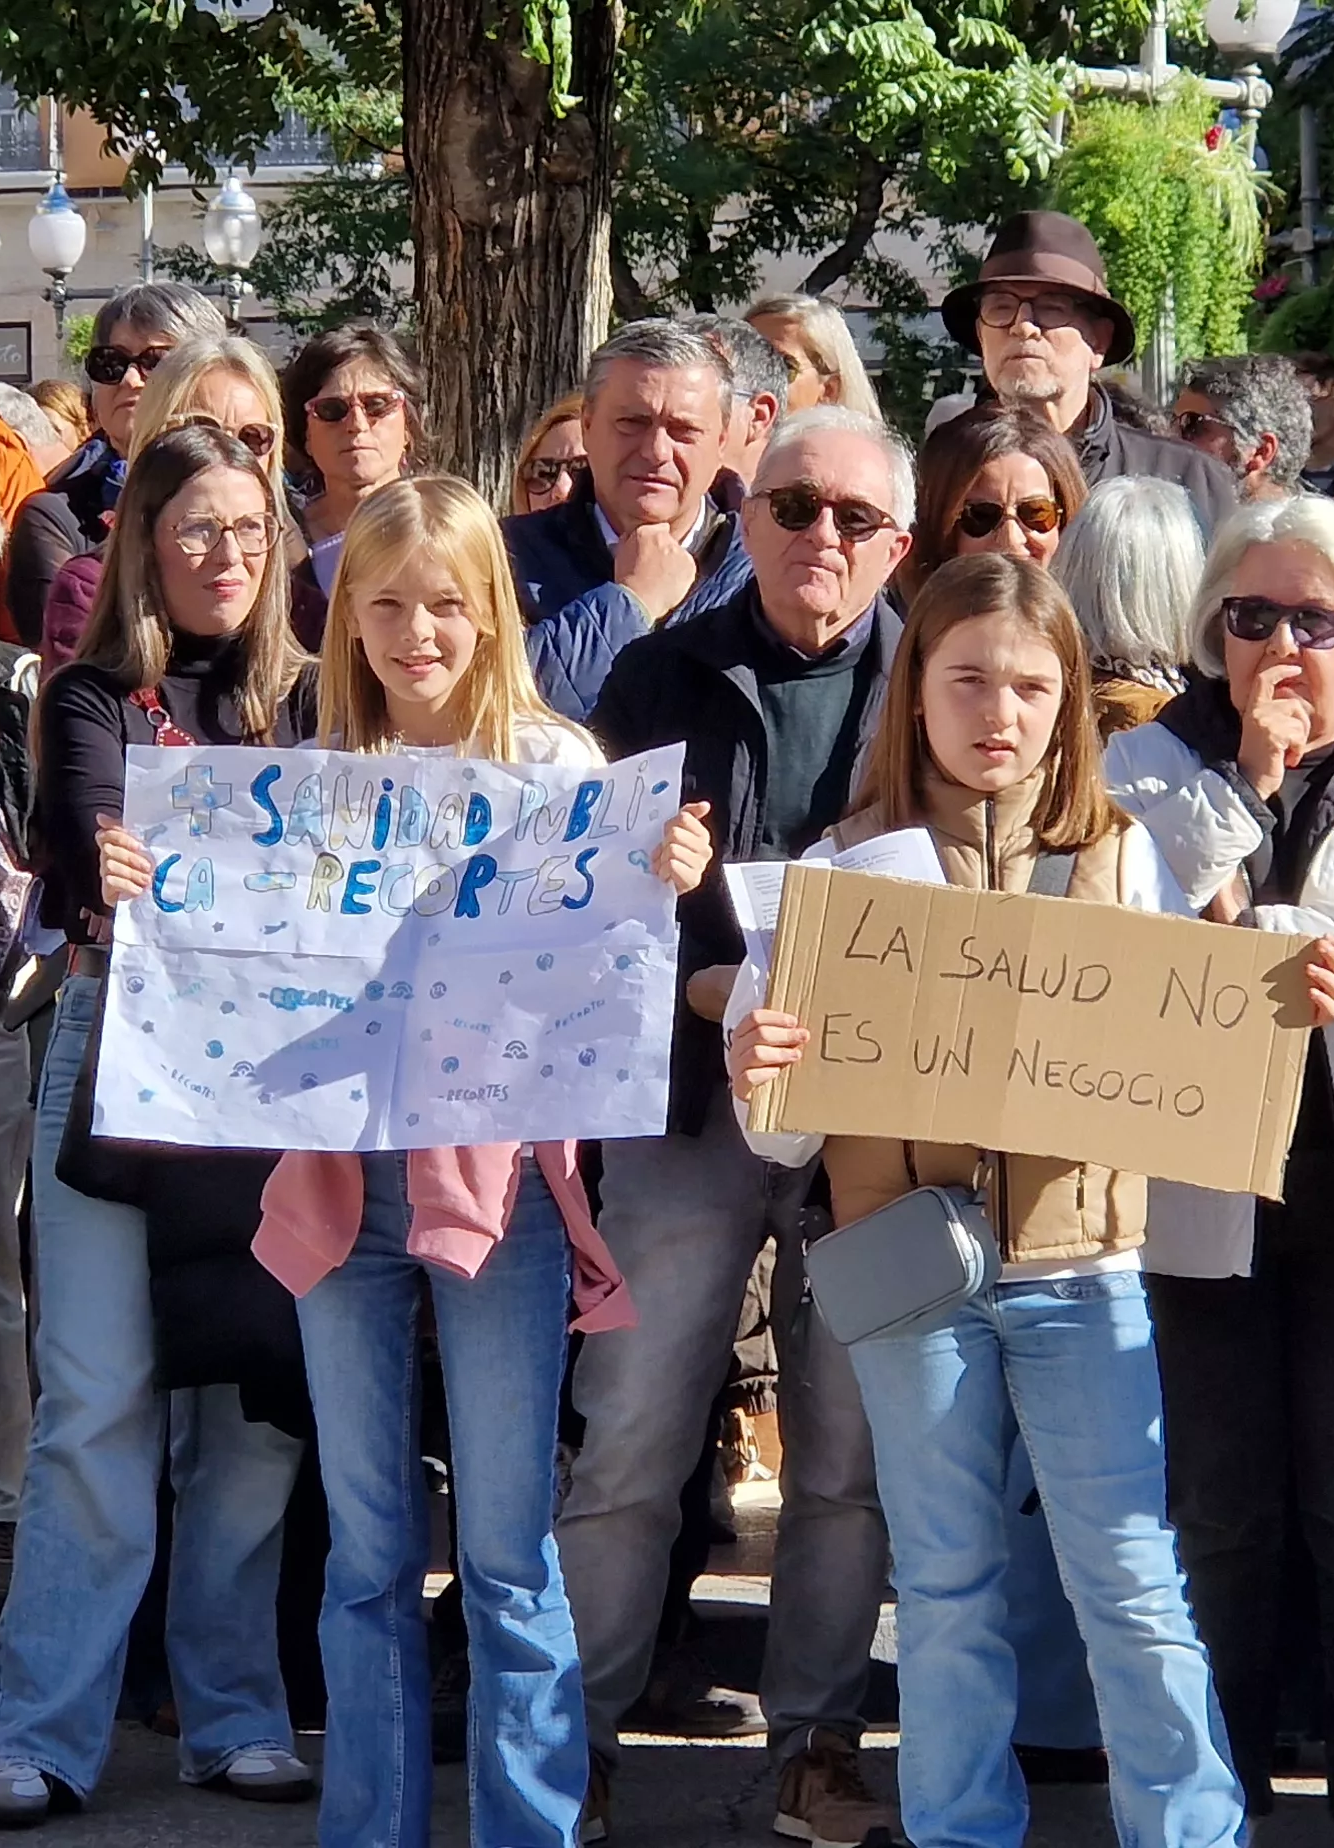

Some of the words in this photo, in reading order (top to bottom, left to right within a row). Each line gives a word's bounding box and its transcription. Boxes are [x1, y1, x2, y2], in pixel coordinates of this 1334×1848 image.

[152, 853, 215, 913] CA
[307, 847, 600, 919] RECORTES
[845, 899, 913, 973] LA
[940, 936, 1112, 1003] SALUD
[1159, 953, 1249, 1029] NO
[820, 1013, 883, 1065] ES
[914, 1027, 975, 1077] UN
[1008, 1040, 1205, 1118] NEGOCIO
